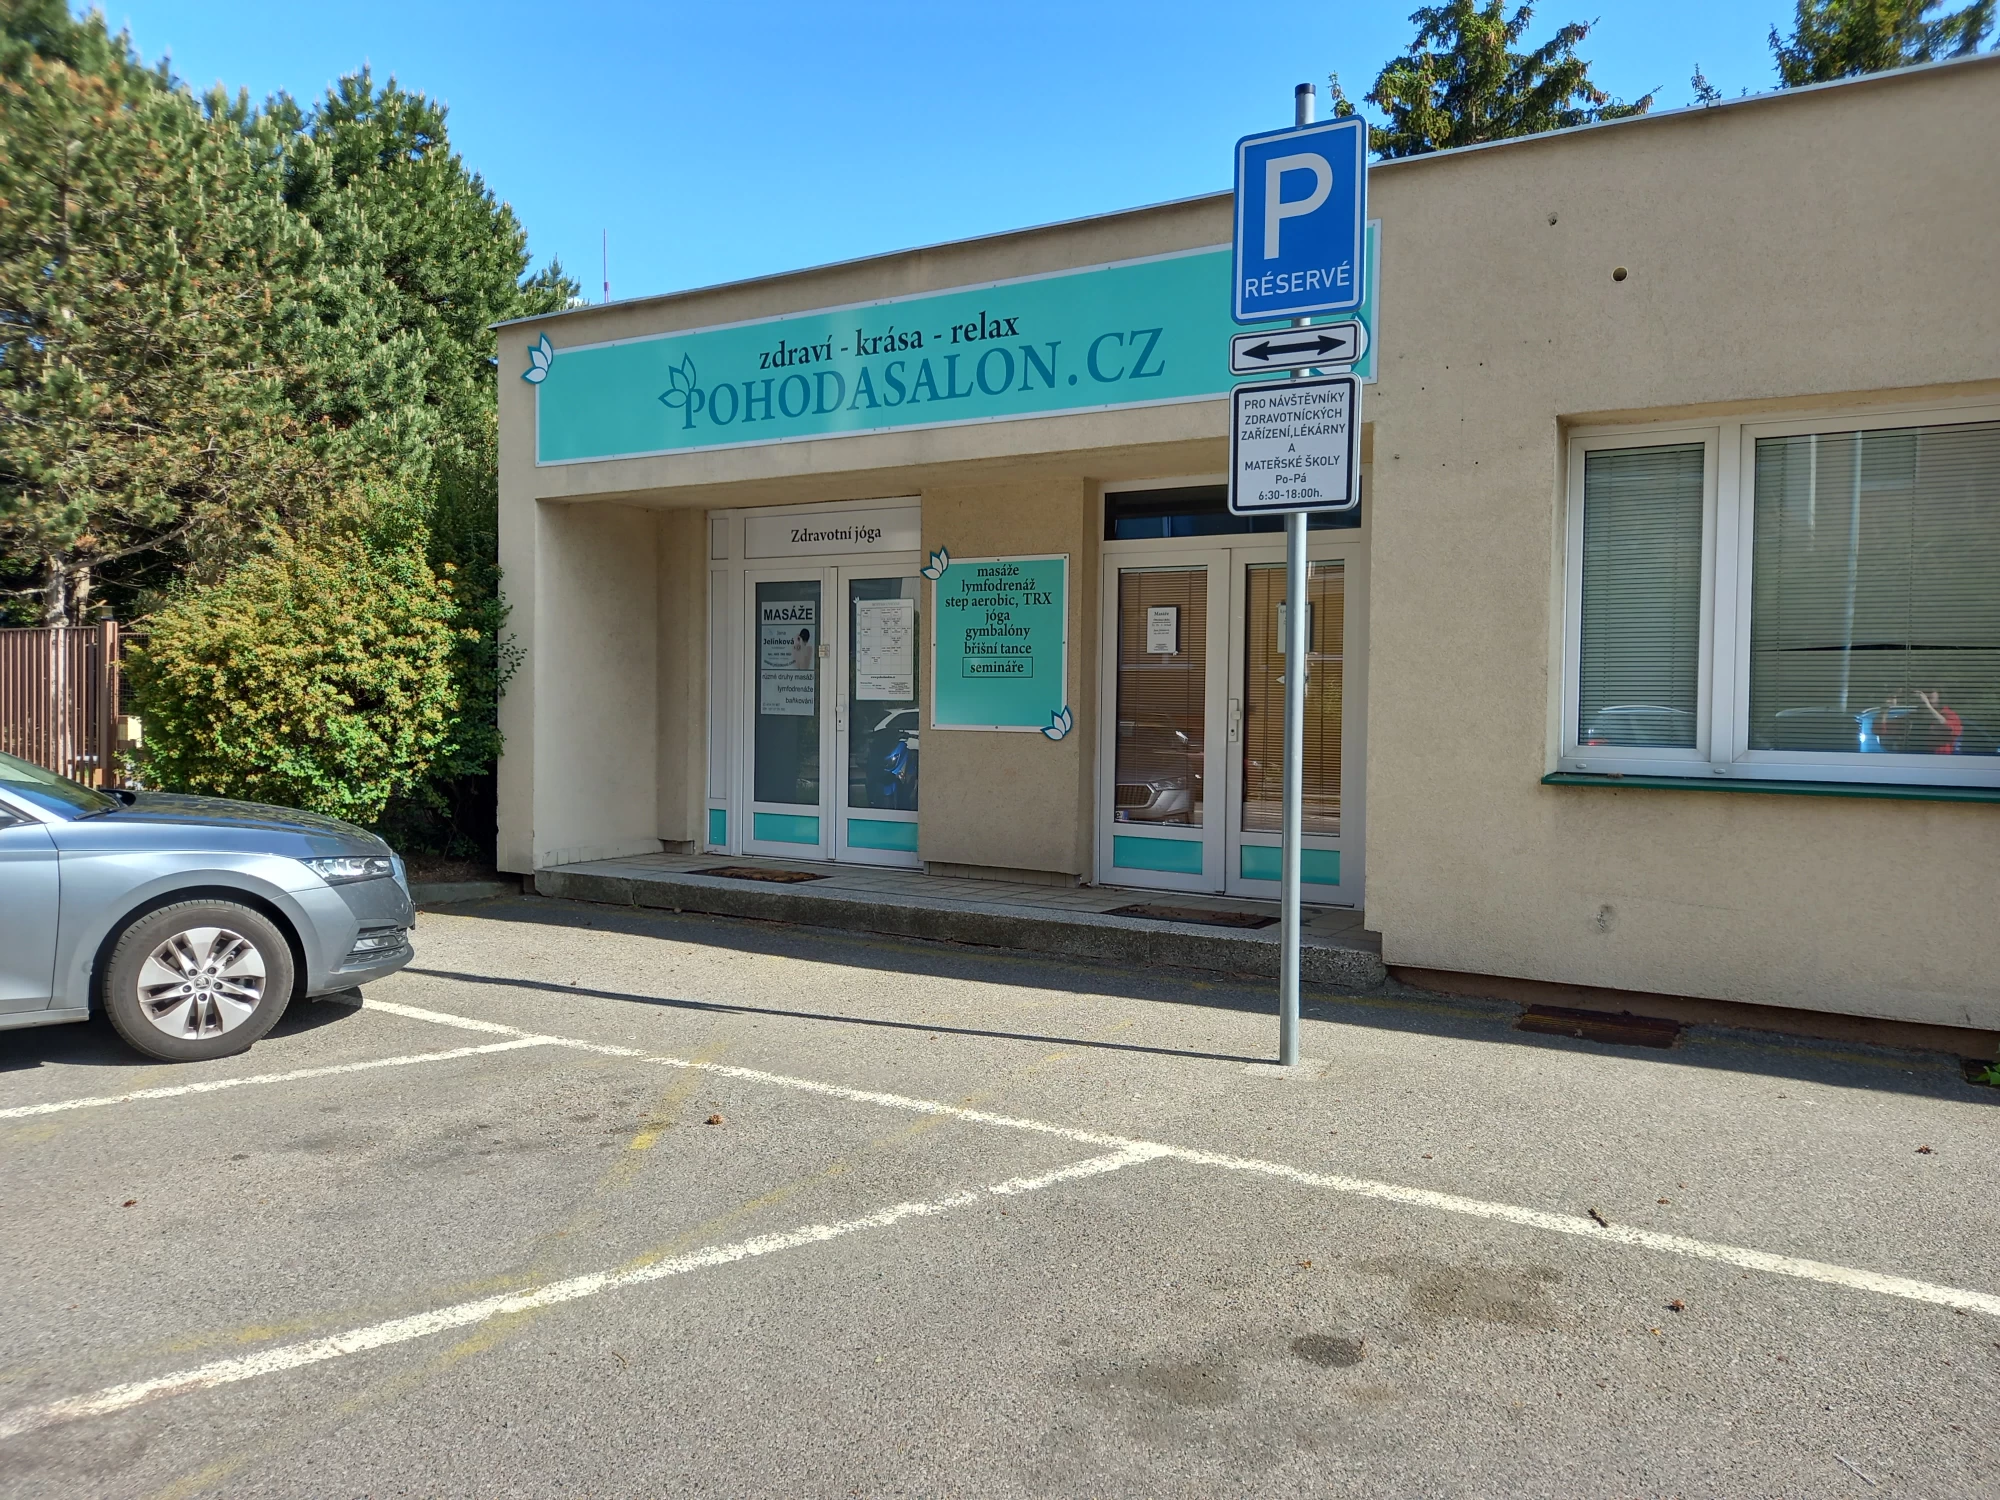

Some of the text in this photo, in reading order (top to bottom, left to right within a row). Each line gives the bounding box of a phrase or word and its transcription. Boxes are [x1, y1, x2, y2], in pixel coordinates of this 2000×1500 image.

[1264, 152, 1333, 260] P
[1245, 261, 1350, 298] RÉSERVÉ
[759, 335, 832, 371] zdraví
[855, 326, 923, 356] krása
[951, 311, 1020, 344] relax
[682, 327, 1166, 429] POHODASALON.CZ
[1244, 391, 1345, 410] PRO NÁVŠTĚVNÍKY
[1245, 406, 1343, 425] ZDRAVOTNÍCKÝCH
[1288, 443, 1296, 452] A
[1244, 453, 1340, 471] MATEŘSKÉ ŠKOLY
[1275, 472, 1307, 485] Po-Pá
[791, 525, 881, 544] Zdravotní jóga
[977, 564, 1020, 577] masáže
[961, 578, 1036, 593] lymfodrenáž
[945, 592, 1052, 611] step aerobic, TRX
[764, 605, 813, 621] MASÁŽE
[984, 609, 1011, 625] jóga
[965, 624, 1031, 641] gymbalóny
[964, 641, 1032, 654] břišní tance
[970, 661, 1024, 673] semináře
[778, 673, 794, 681] druhy
